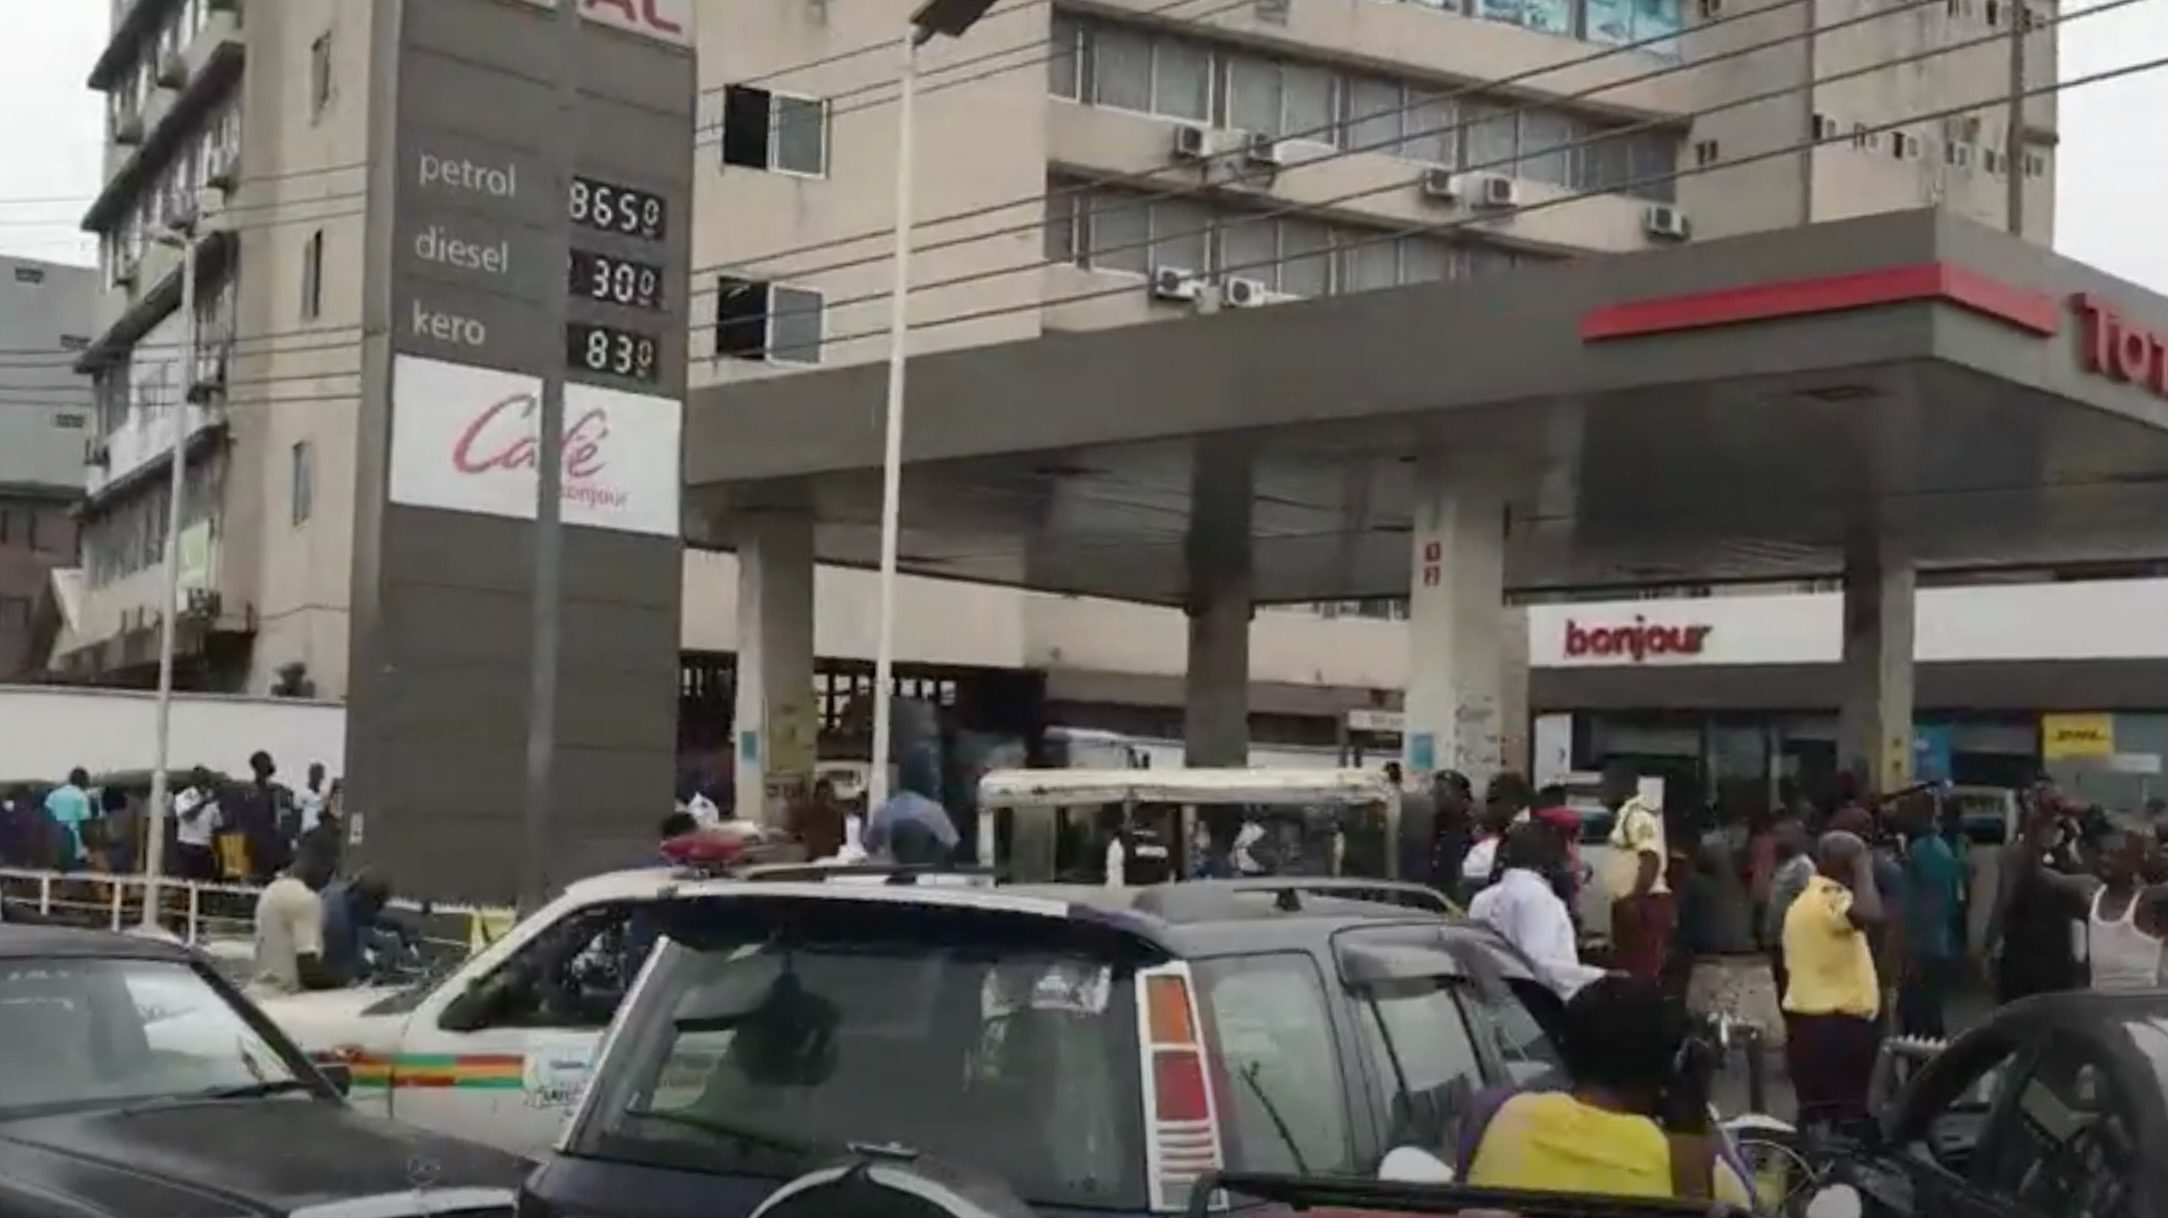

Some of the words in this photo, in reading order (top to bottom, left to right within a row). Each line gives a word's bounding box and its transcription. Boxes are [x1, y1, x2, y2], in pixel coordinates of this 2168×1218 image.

[419, 153, 516, 197] petrol
[415, 226, 509, 273] diesel
[413, 301, 485, 345] kero
[1565, 614, 1713, 662] bonjour
